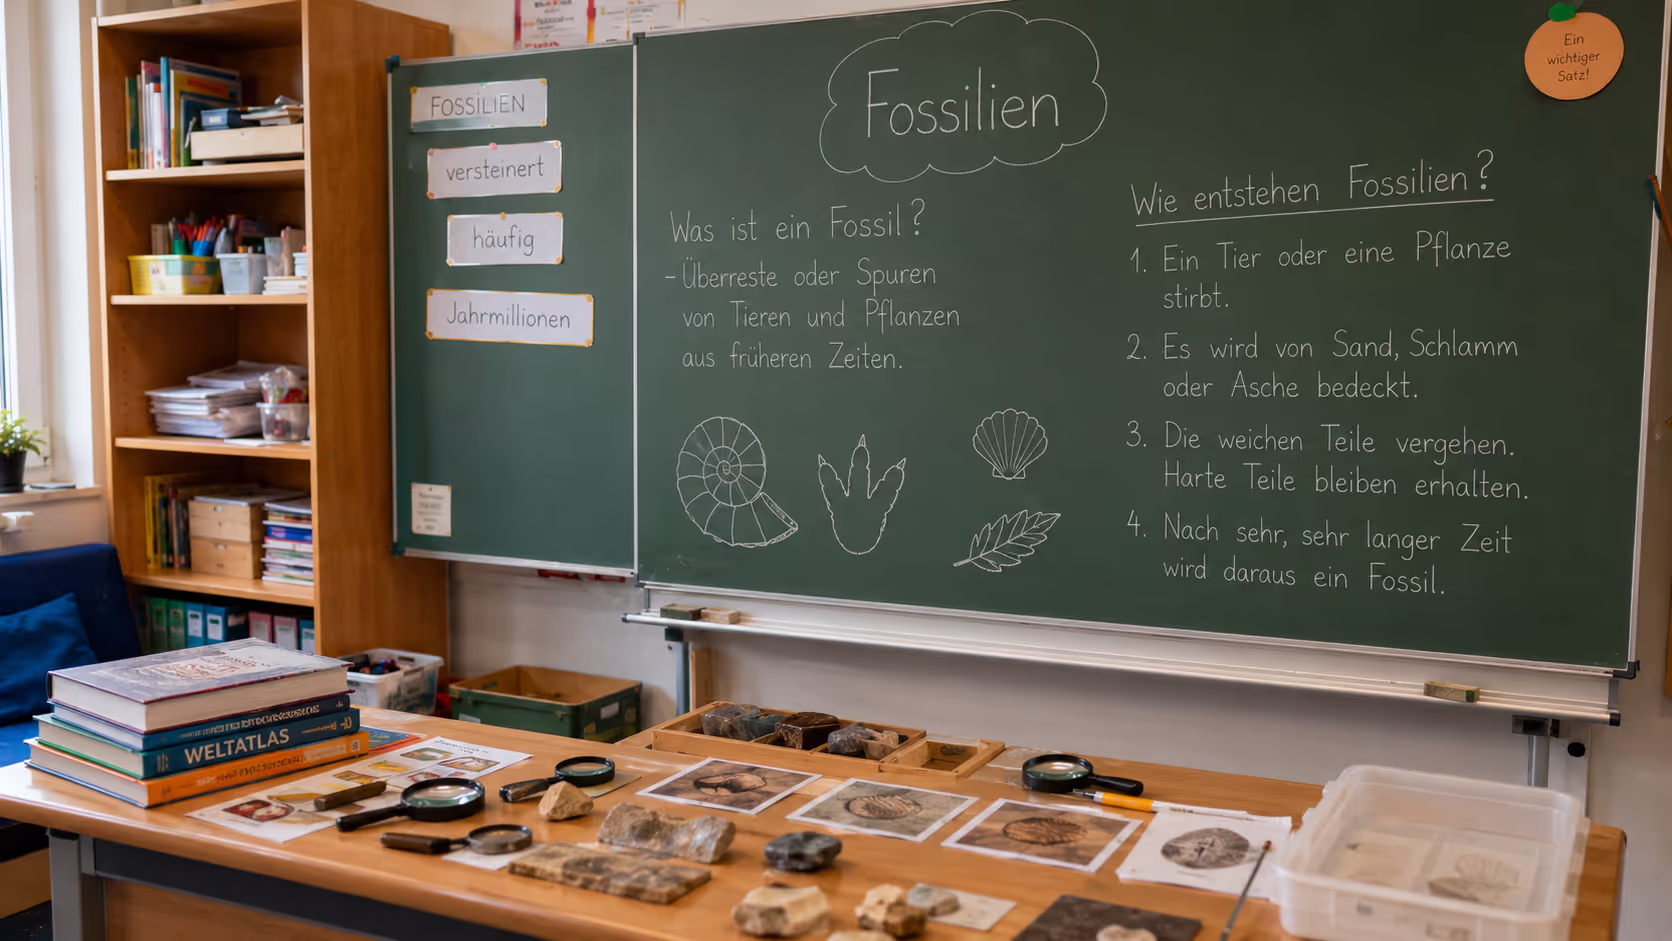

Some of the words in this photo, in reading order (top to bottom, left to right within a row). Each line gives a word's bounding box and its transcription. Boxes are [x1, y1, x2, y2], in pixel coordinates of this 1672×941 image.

[1563, 32, 1585, 47] Ein
[1546, 51, 1601, 66] wichtiger
[1557, 67, 1590, 83] Satz!
[866, 66, 1059, 138] Fossilien
[445, 154, 545, 182] versteinert
[1130, 181, 1178, 216] Wie
[1193, 171, 1320, 211] entstehen
[473, 223, 535, 257] häufig
[669, 209, 714, 243] Was
[731, 209, 758, 241] ist
[775, 214, 810, 240] ein
[1130, 246, 1147, 273] 1.
[1163, 243, 1199, 272] Ein
[1216, 241, 1262, 270] Tier
[1278, 238, 1328, 267] oder
[1344, 240, 1395, 264] eine
[1416, 229, 1512, 268] Pflanze
[794, 258, 840, 287] oder
[856, 256, 936, 297] Spuren
[1163, 281, 1229, 309] stirbt.
[446, 300, 571, 329] Jahrmillionen
[682, 312, 715, 328] von
[729, 299, 791, 328] Tieren
[807, 299, 845, 328] und
[865, 298, 960, 335] Pflanzen
[682, 352, 716, 368] aus
[729, 340, 812, 369] früheren
[828, 341, 903, 369] Zeiten.
[1126, 332, 1147, 360] 2.
[1163, 331, 1191, 360] Es
[1209, 330, 1258, 359] wird
[1275, 342, 1313, 358] von
[1332, 328, 1399, 362] Sand,
[1409, 328, 1519, 357] Schlamm
[1163, 370, 1214, 398] oder
[1230, 369, 1300, 398] Asche
[1317, 370, 1418, 399] bedeckt.
[1125, 419, 1147, 448] 3.
[1164, 420, 1201, 449] Die
[1218, 423, 1303, 451] weichen
[1320, 423, 1376, 453] Teile
[1395, 425, 1515, 466] vergehen.
[1164, 459, 1227, 489] Harte
[1242, 462, 1296, 492] Teile
[1315, 464, 1397, 495] bleiben
[1415, 468, 1529, 500] erhalten.
[1126, 509, 1147, 538] 4.
[1164, 511, 1219, 541] Nach
[1236, 516, 1288, 549] sehr,
[1301, 518, 1350, 547] sehr
[1366, 519, 1441, 561] langer
[1460, 523, 1513, 554] Zeit
[1162, 553, 1207, 580] wird
[1223, 554, 1296, 586] daraus
[1313, 566, 1348, 589] ein
[1369, 561, 1445, 595] Fossil.
[184, 728, 290, 764] WELTATLAS
